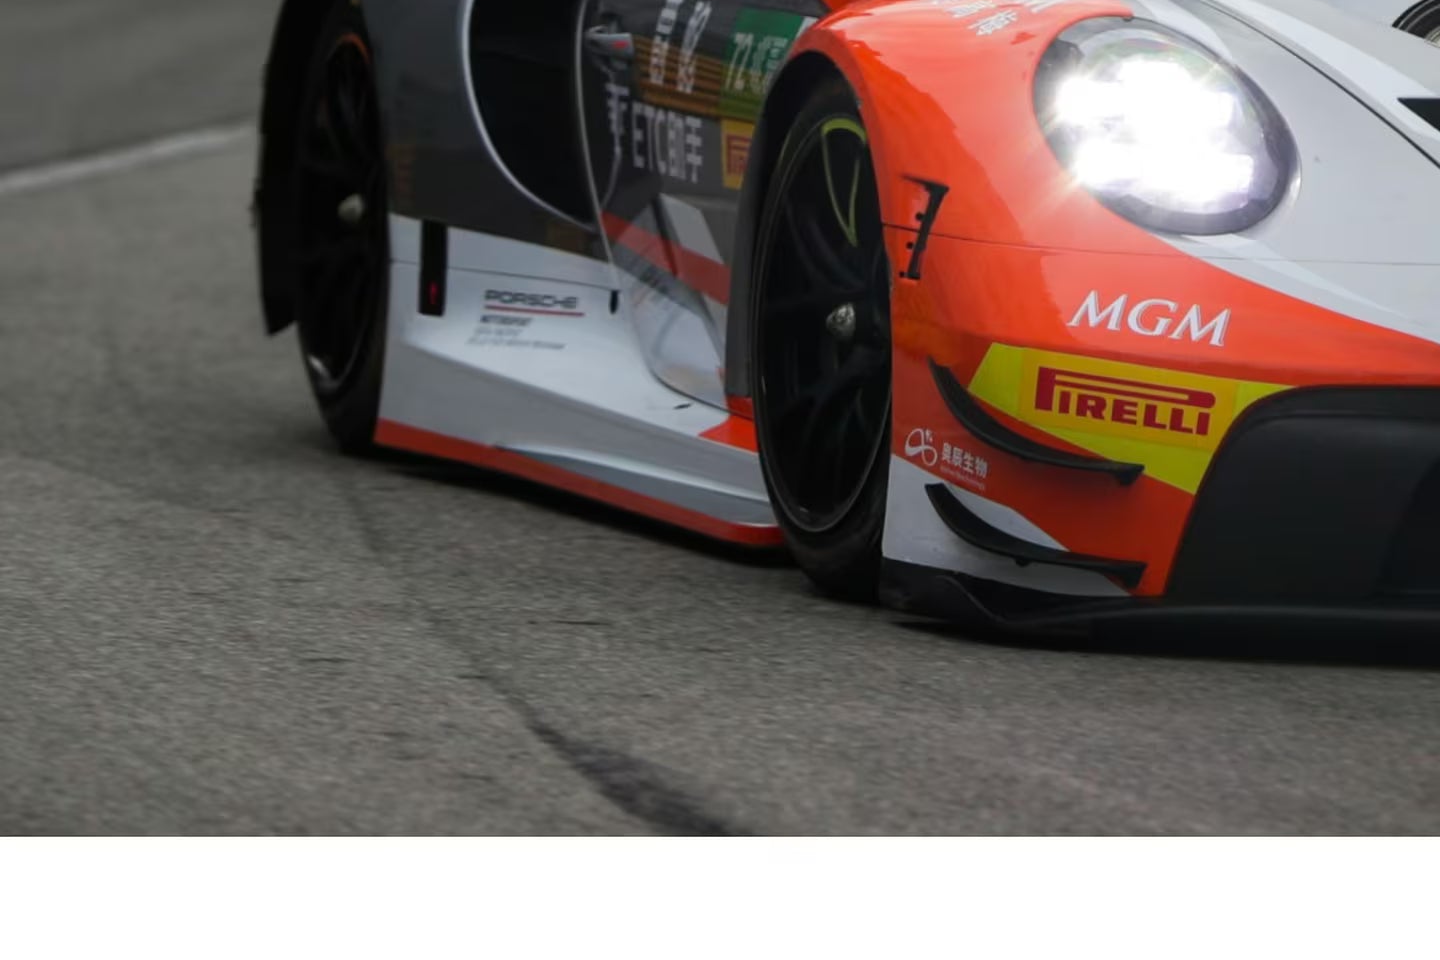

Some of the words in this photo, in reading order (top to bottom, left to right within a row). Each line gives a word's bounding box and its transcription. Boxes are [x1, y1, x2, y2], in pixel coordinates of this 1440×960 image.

[484, 289, 579, 309] PORSCHE
[1066, 290, 1232, 347] MGM
[1034, 366, 1217, 436] PIRELLI
